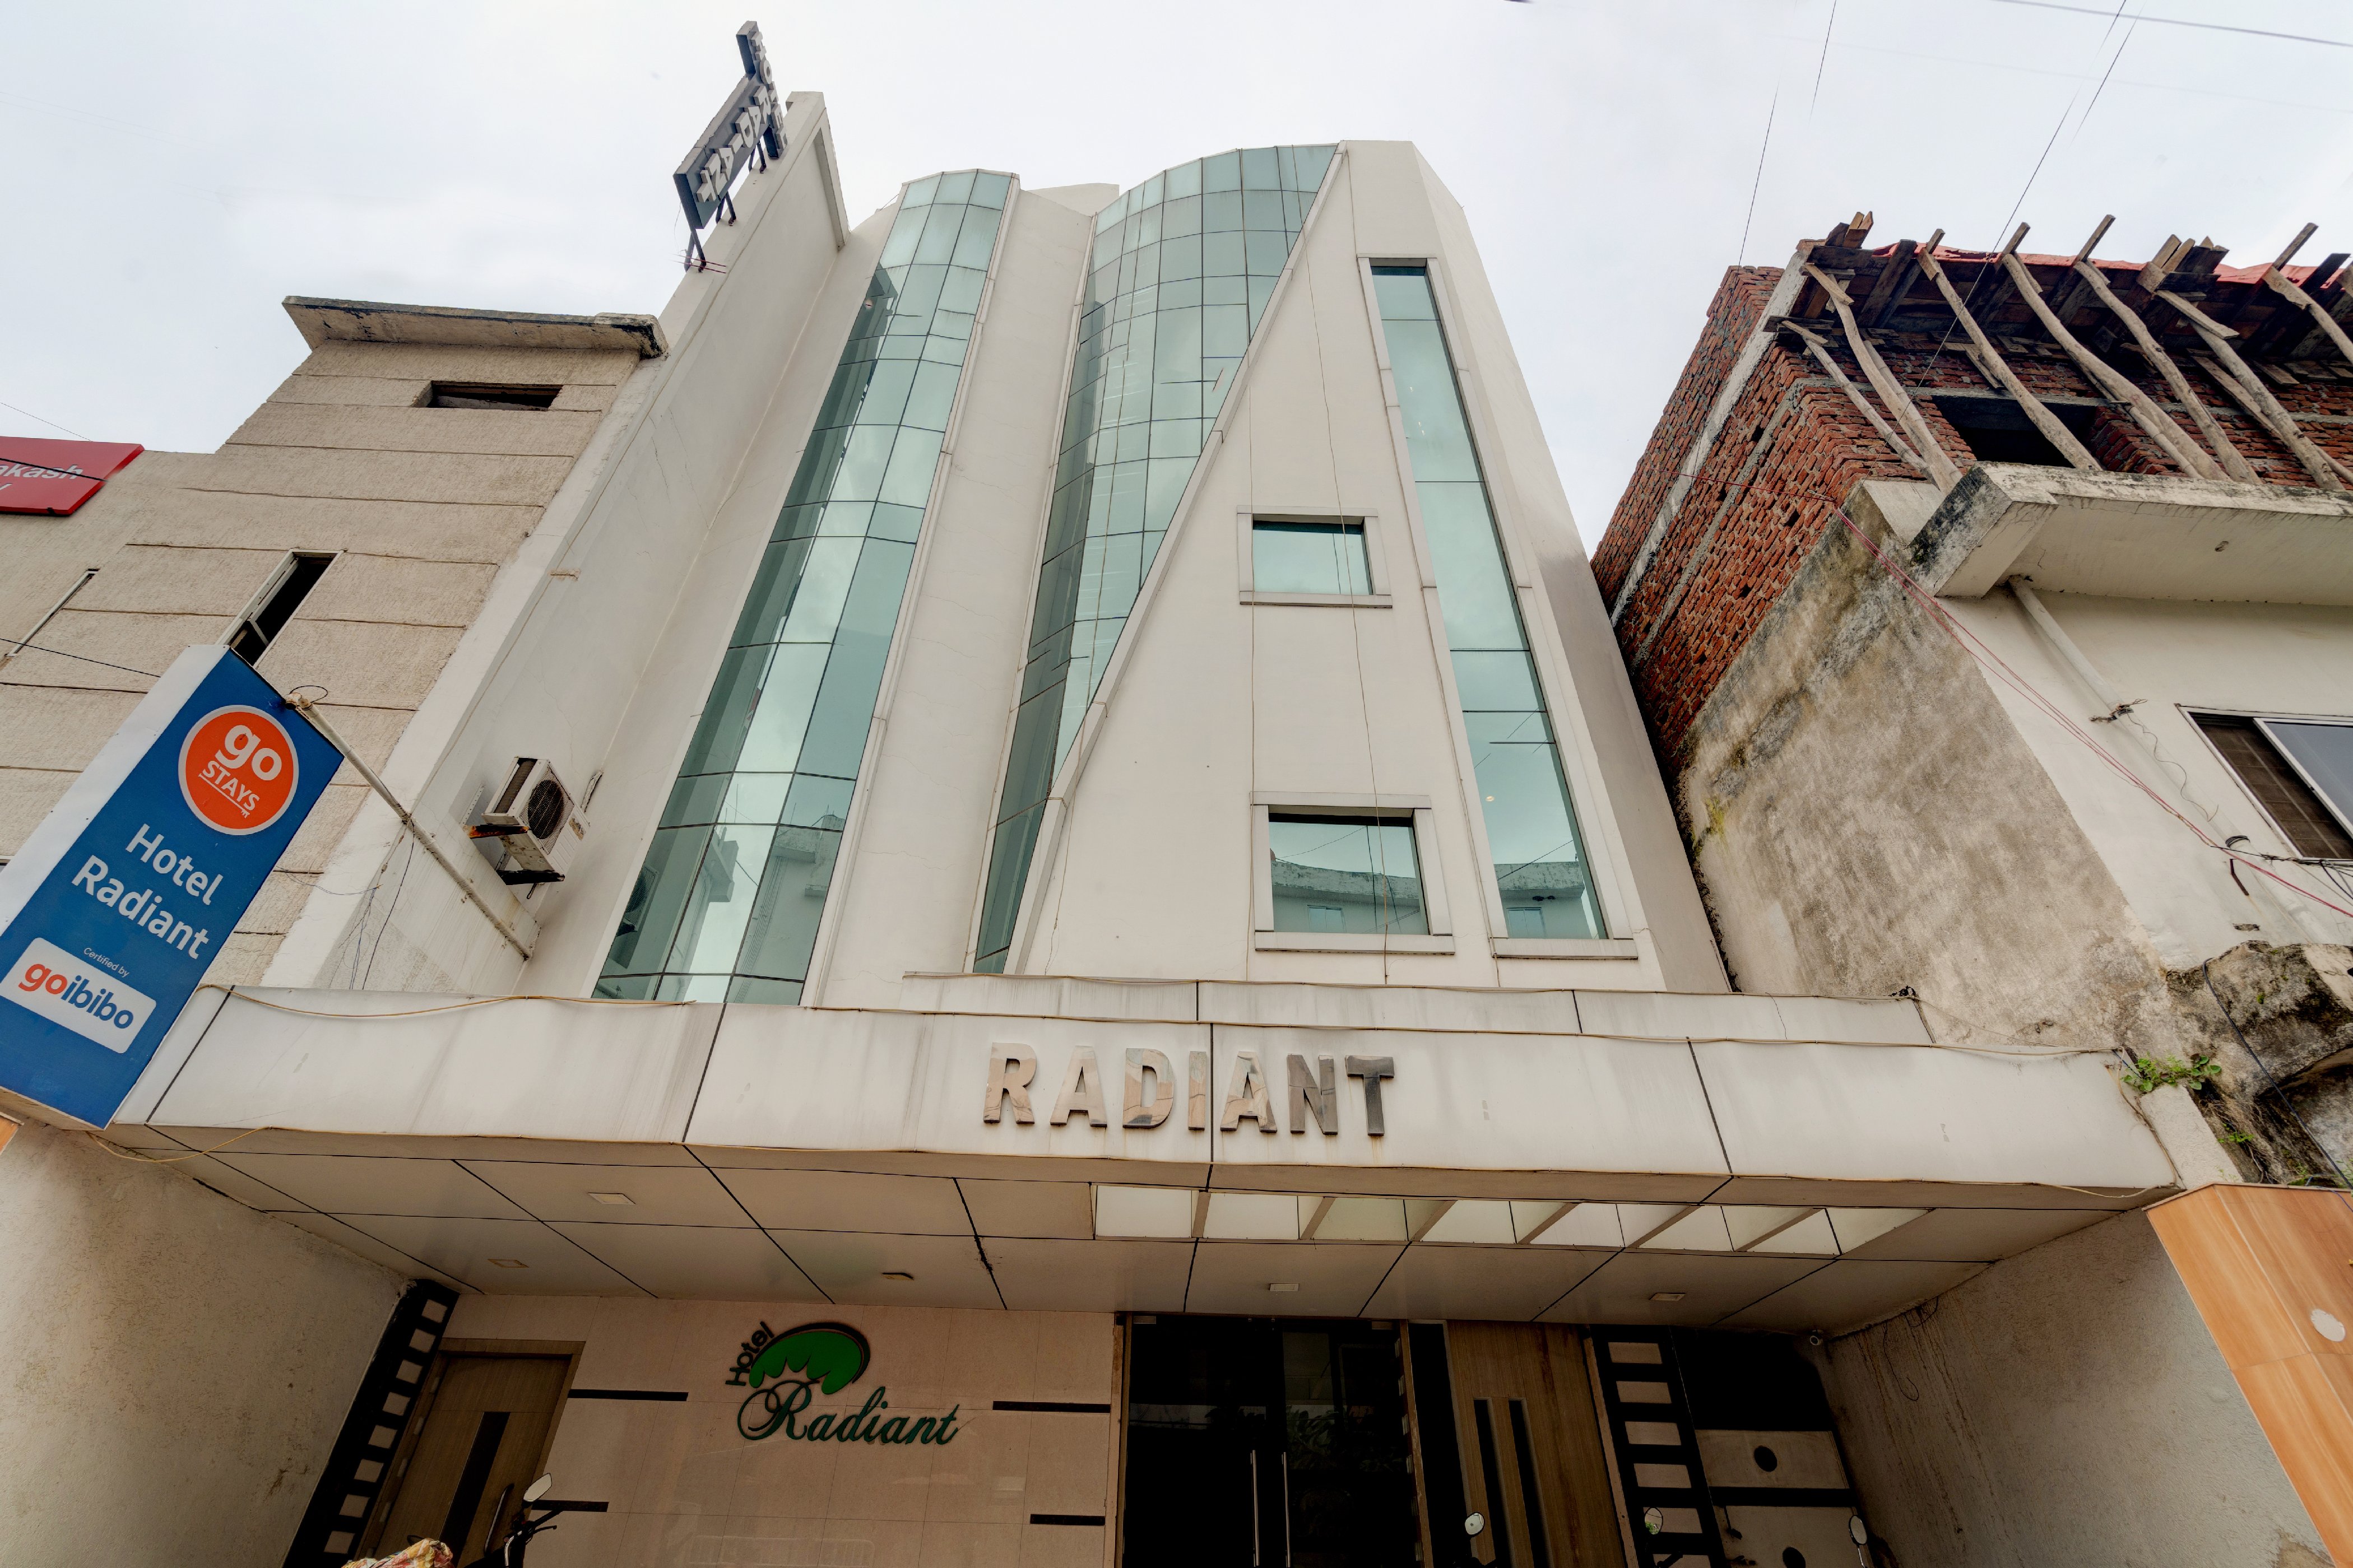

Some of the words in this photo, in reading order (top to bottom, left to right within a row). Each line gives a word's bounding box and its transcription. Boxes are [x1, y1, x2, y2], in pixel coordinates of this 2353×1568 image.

[751, 31, 787, 150] HOTEL
[697, 85, 771, 203] RADIANT
[202, 760, 260, 812] STAYS
[215, 725, 282, 781] go
[125, 823, 225, 906] Hotel
[72, 855, 210, 960] Radiant
[83, 947, 120, 971] Certified
[118, 966, 129, 978] by
[18, 963, 134, 1029] goibibo
[982, 1042, 1395, 1137] RADIANT
[725, 1321, 774, 1386] Hotel
[737, 1379, 960, 1445] Radiant
